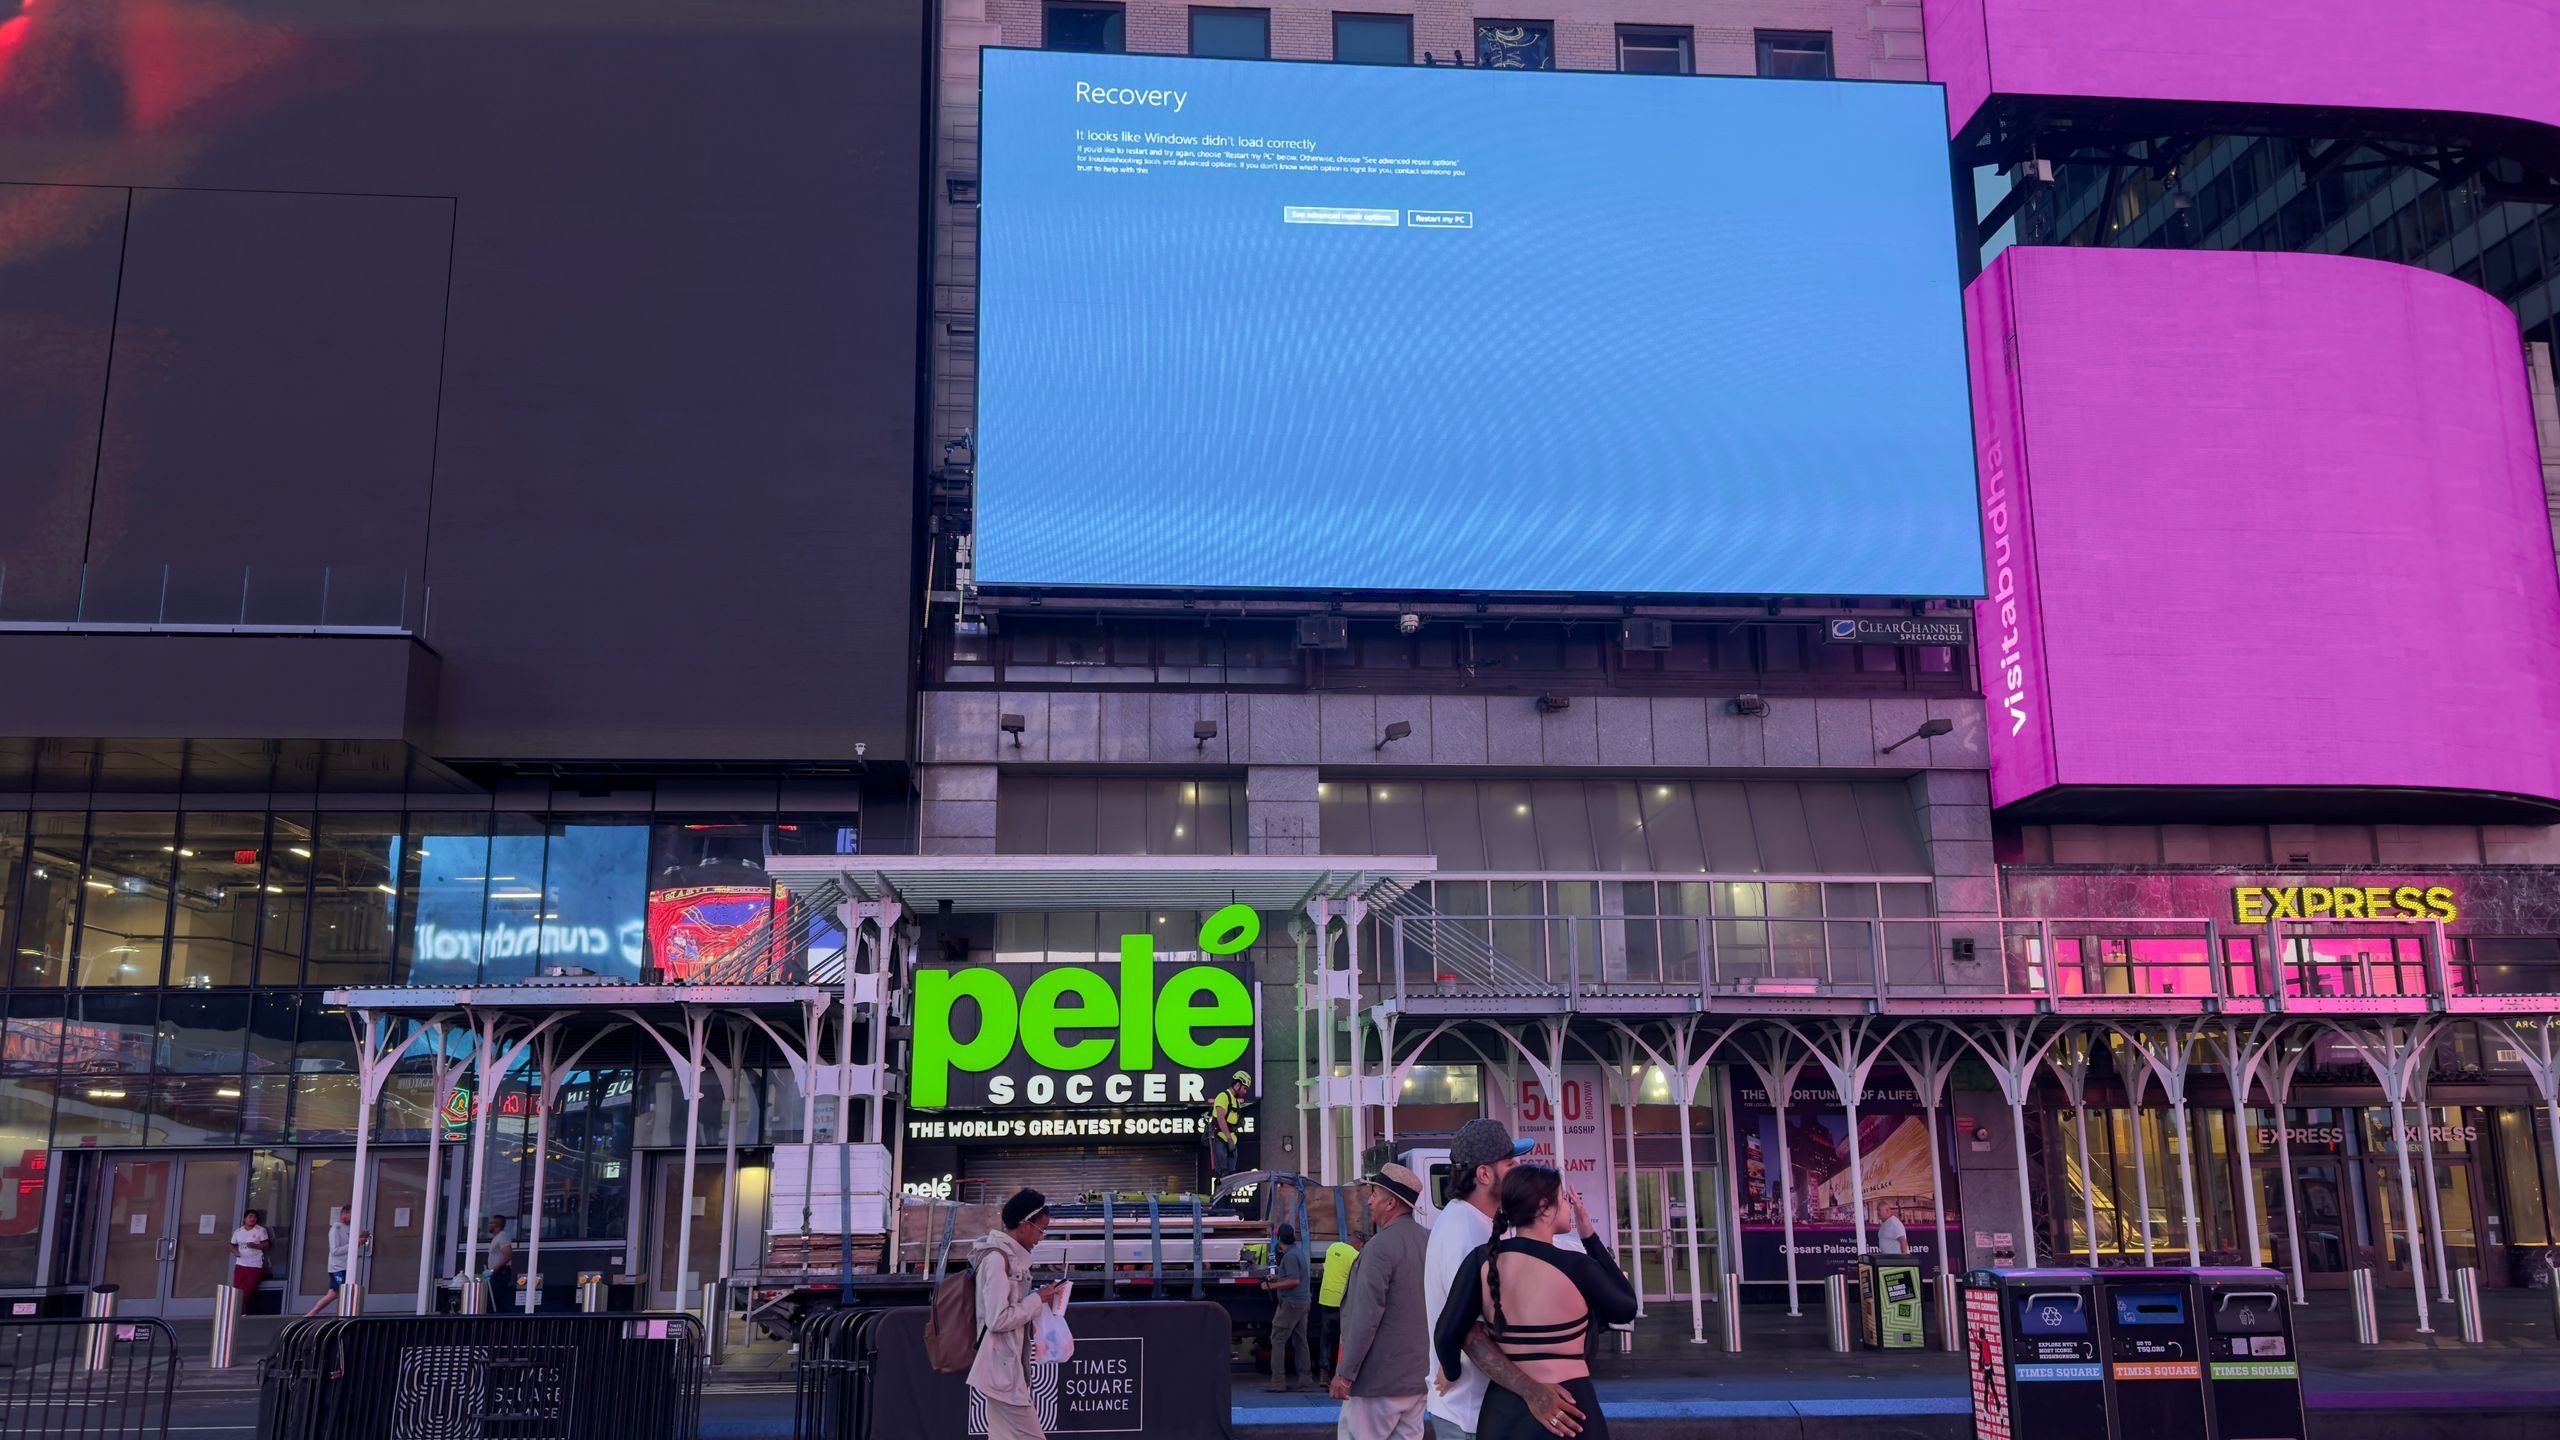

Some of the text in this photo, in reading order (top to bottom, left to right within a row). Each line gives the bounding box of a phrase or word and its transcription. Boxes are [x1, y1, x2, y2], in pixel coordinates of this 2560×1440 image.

[1076, 82, 1187, 112] Recovery
[1076, 129, 1316, 152] It looks like Windows didn't load correctly
[1088, 155, 1142, 165] troubleshooting
[1177, 159, 1210, 167] advanced
[1260, 162, 1278, 170] don't
[1279, 163, 1297, 171] know
[1350, 166, 1366, 174] right
[1126, 147, 1148, 155] restart
[1149, 148, 1162, 156] and
[1164, 149, 1173, 157] try
[1251, 153, 1261, 161] my
[1336, 155, 1360, 163] choose
[1378, 157, 1410, 165] advanced
[1411, 159, 1430, 167] repair
[1103, 166, 1118, 174] help
[1307, 211, 1341, 220] advanced
[1415, 214, 1465, 224] Restart my PC
[1900, 633, 1963, 641] SPECTACOLOR
[2235, 886, 2457, 924] EXPRESS
[911, 904, 1260, 1107] pelé
[987, 1073, 1205, 1104] SOCCER
[1741, 1089, 1766, 1100] THE
[1877, 1090, 1887, 1100] A
[1584, 1081, 1594, 1120] BROADWAY
[909, 1121, 944, 1138] THE
[948, 1120, 1026, 1138] WORLD'S
[1029, 1118, 1122, 1137] GREATEST
[1124, 1117, 1195, 1135] SOCCER
[1564, 1125, 1596, 1135] LAGSHIP
[2258, 1127, 2343, 1144] EXPRESS
[2392, 1126, 2478, 1142] XRESS
[1778, 1244, 1822, 1254] Cesars
[1823, 1244, 1857, 1254] Palace
[1072, 1359, 1127, 1375] TIMES
[2018, 1367, 2100, 1378] TIMES SQUARE
[2116, 1366, 2198, 1377] TIMES SQUARE
[2213, 1366, 2295, 1376] TIMES SQUARE
[1066, 1379, 1133, 1397] SQUARE
[1069, 1399, 1129, 1412] ALLIANCE
